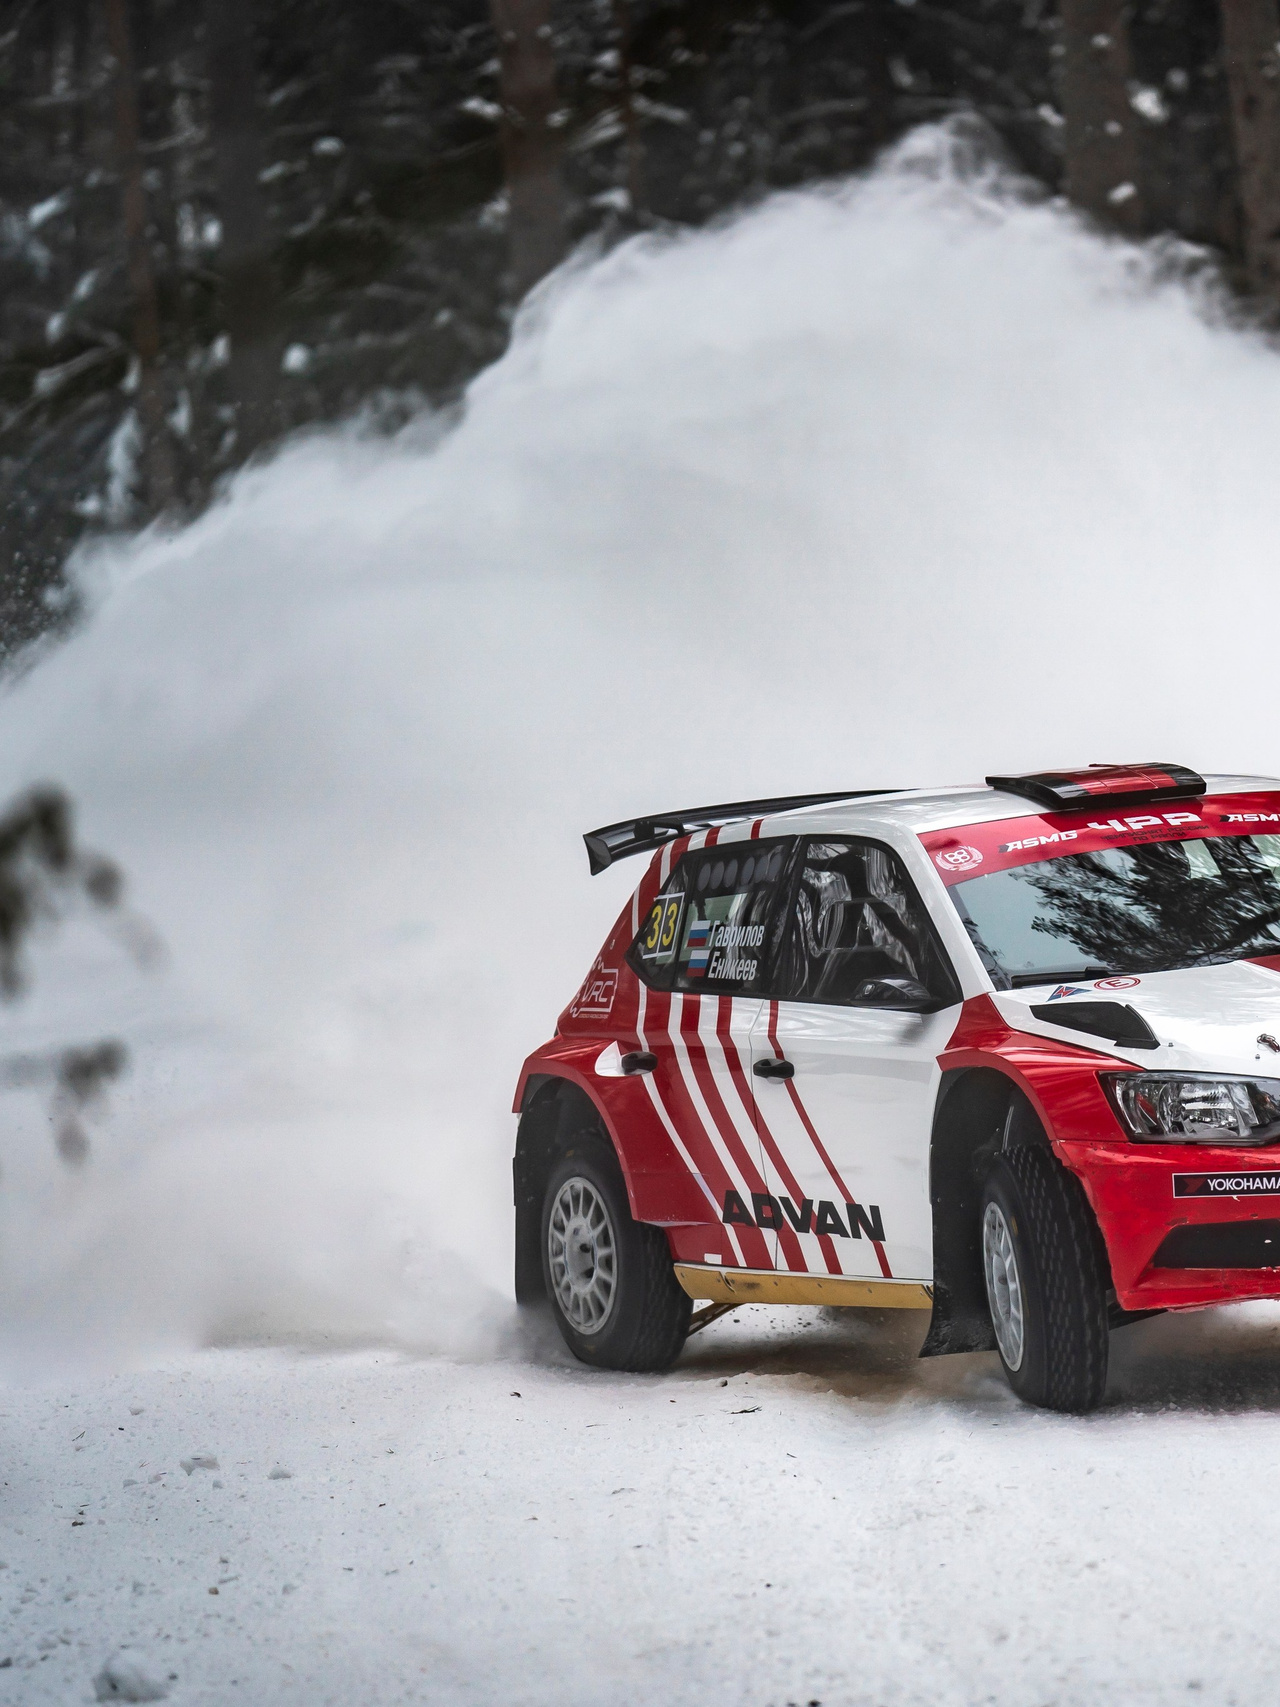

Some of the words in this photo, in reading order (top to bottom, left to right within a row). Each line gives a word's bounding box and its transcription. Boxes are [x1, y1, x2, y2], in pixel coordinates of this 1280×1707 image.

[1006, 830, 1078, 852] ASMG
[646, 903, 678, 949] 33
[709, 921, 765, 953] Гаврилов
[708, 952, 758, 981] Еникеев
[722, 1190, 886, 1241] ADVAN
